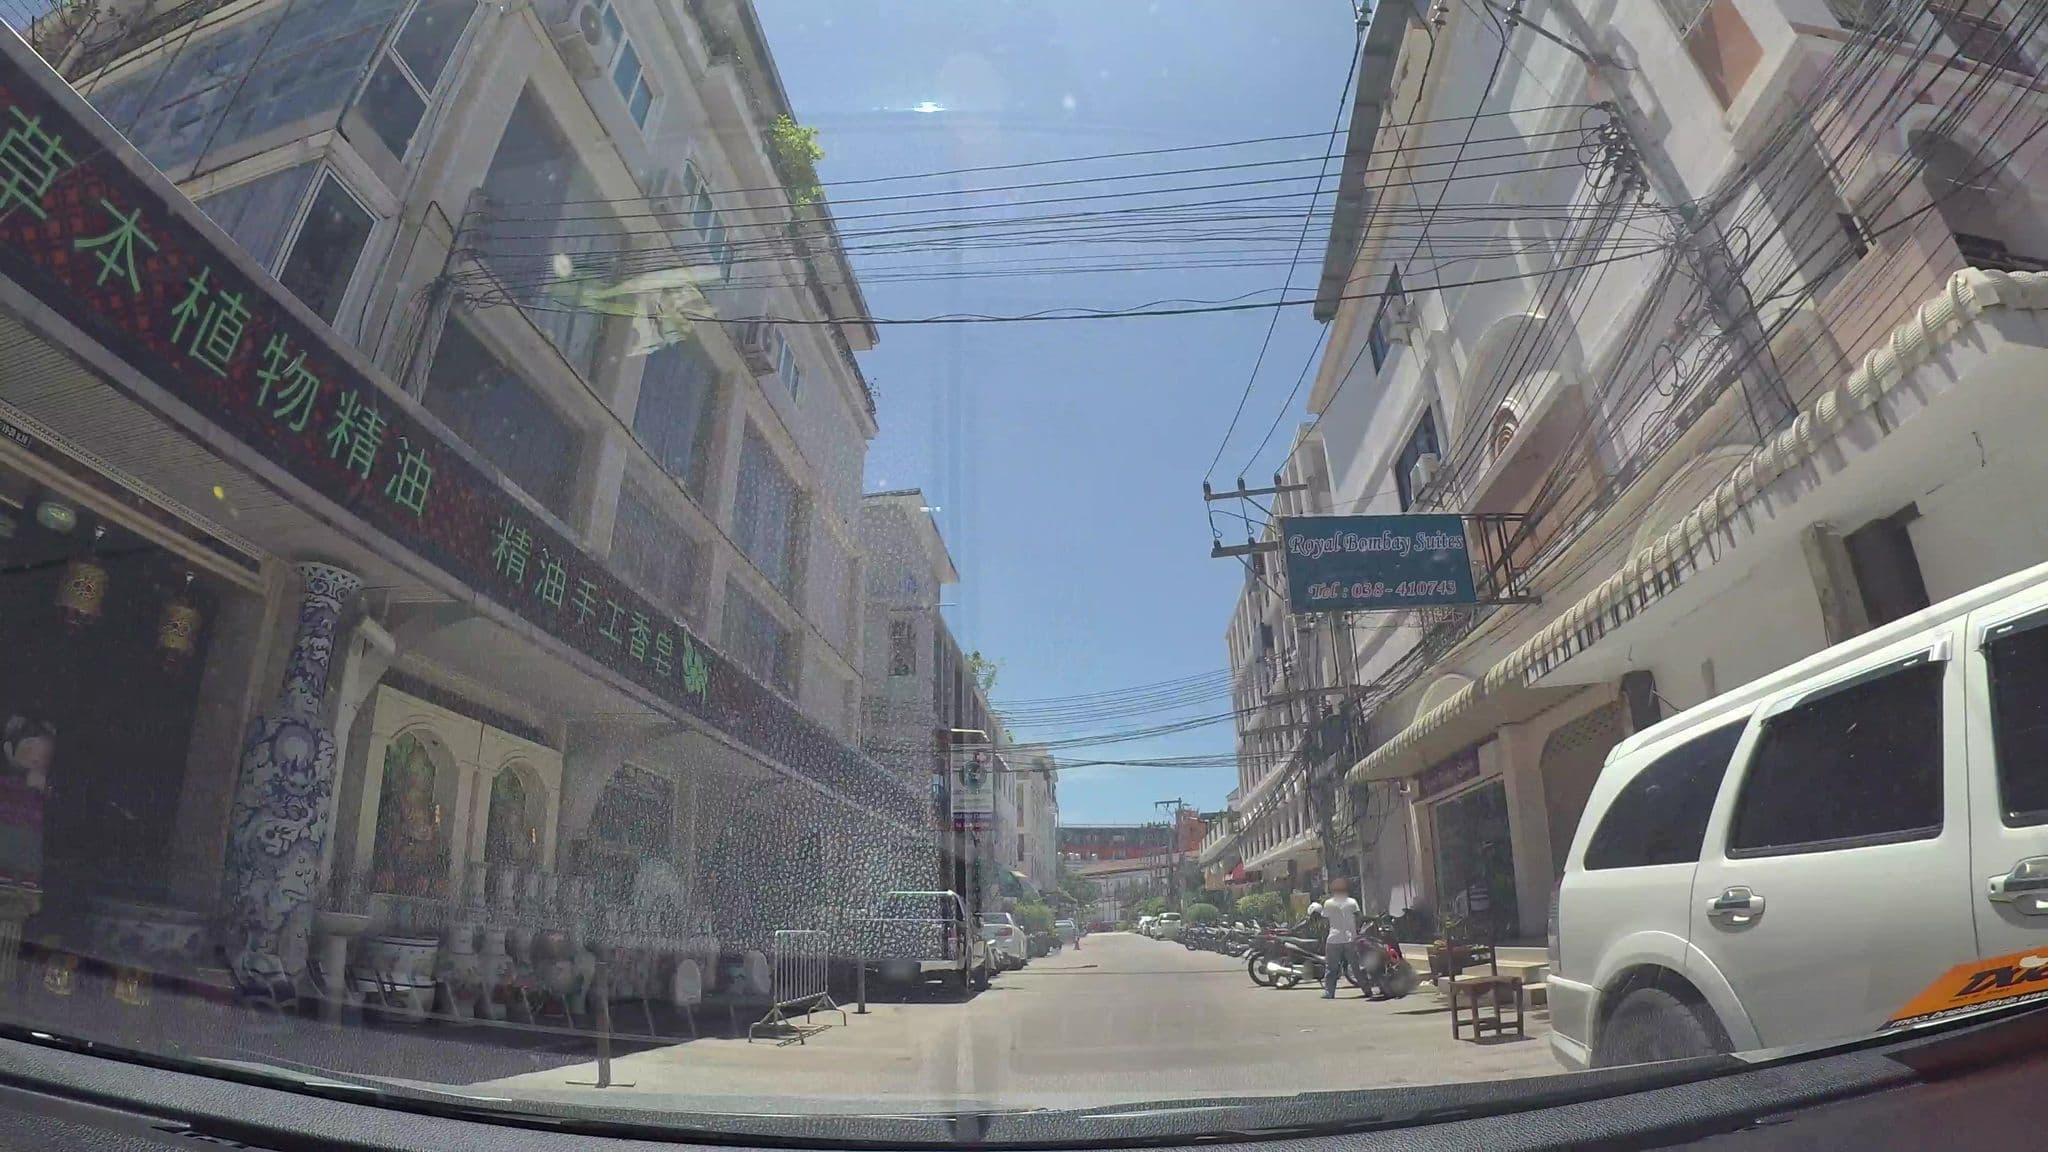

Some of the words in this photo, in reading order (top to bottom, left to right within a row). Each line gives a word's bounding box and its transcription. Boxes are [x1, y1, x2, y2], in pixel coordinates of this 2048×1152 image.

[1289, 531, 1342, 559] Royal
[1343, 530, 1411, 557] Bombay
[1414, 530, 1464, 551] Suites
